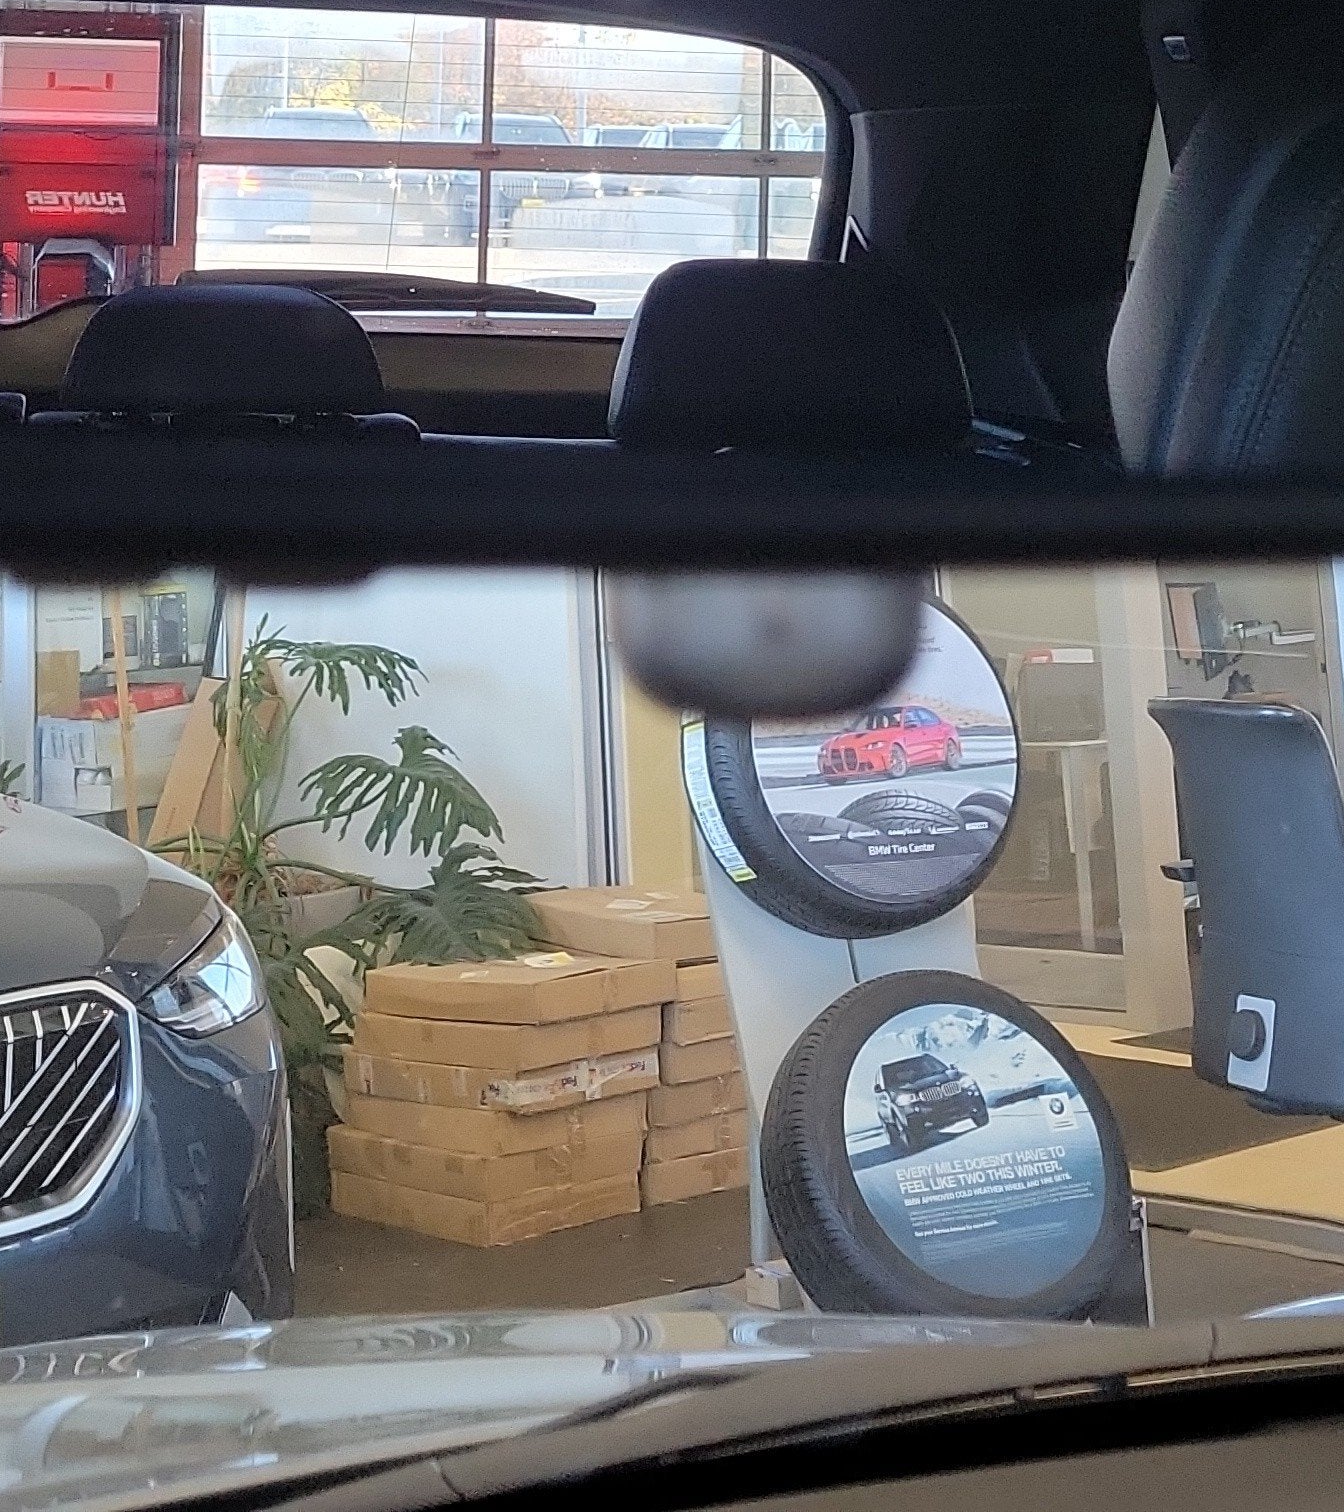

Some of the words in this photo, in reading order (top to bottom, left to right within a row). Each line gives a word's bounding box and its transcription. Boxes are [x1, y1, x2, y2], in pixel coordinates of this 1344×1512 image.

[868, 844, 891, 856] BMW
[891, 844, 909, 854] Tire
[908, 843, 935, 853] Center
[896, 1164, 932, 1181] EVERY
[934, 1160, 964, 1175] MILE
[963, 1152, 1013, 1171] DOESN'T
[1015, 1148, 1049, 1163] HAVE
[1048, 1145, 1066, 1159] TO
[899, 1179, 931, 1195] FEEL
[929, 1175, 958, 1191] LIKE
[956, 1171, 986, 1187] TWO
[984, 1166, 1015, 1182] THIS
[1013, 1160, 1063, 1178] WINTER.
